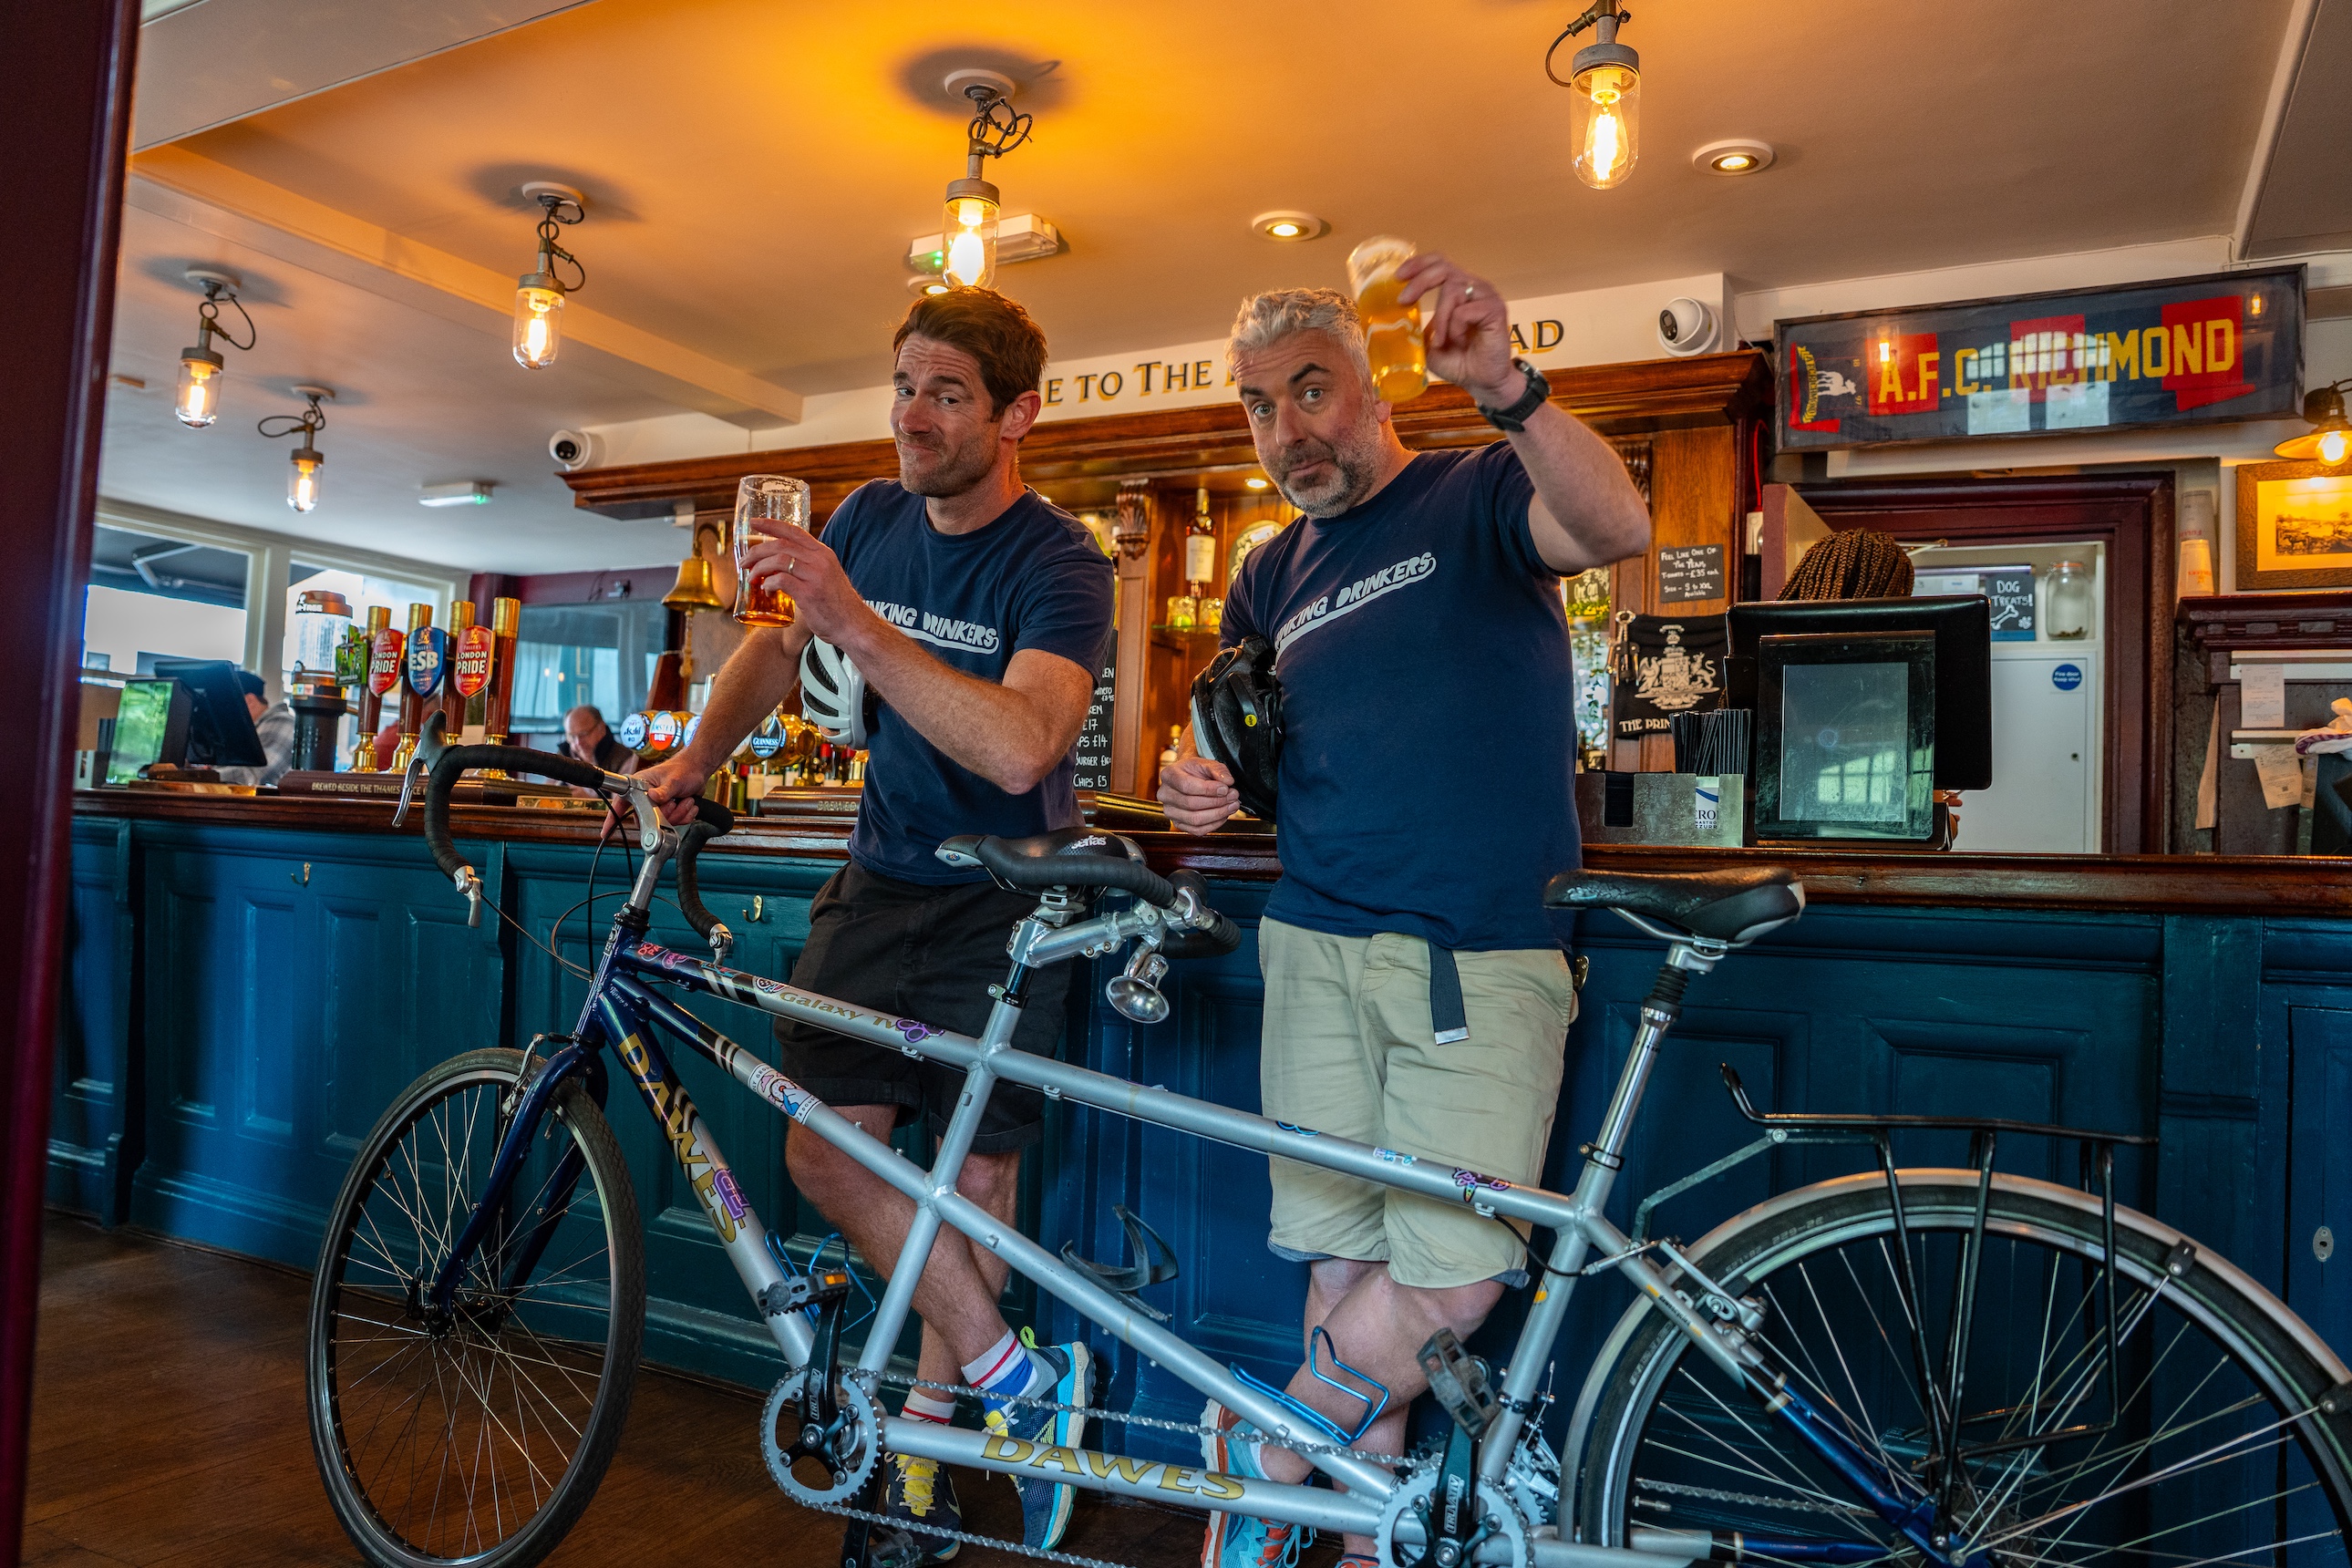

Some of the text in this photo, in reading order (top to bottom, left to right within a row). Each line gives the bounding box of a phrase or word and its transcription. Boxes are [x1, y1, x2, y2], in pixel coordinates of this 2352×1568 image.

[1074, 371, 1123, 403] TO
[1133, 360, 1212, 397] THE
[1336, 552, 1432, 608] DRINKERS
[1996, 580, 2020, 593] DOG
[1990, 593, 2033, 607] TREATS!
[923, 612, 997, 647] DRINKERS
[410, 651, 438, 671] ESB
[458, 651, 487, 659] LONDON
[370, 659, 396, 674] PRIDE
[457, 660, 486, 674] PRIDE
[1619, 718, 1643, 732] THE
[753, 738, 779, 746] GUINNESS
[1077, 734, 1108, 748] PS £14
[1098, 775, 1107, 787] £5
[312, 782, 400, 795] BREWED BESIDE THE THAMES
[779, 991, 864, 1021] Galaxy
[619, 1032, 746, 1243] DAWES
[982, 1435, 1245, 1500] DAWES
